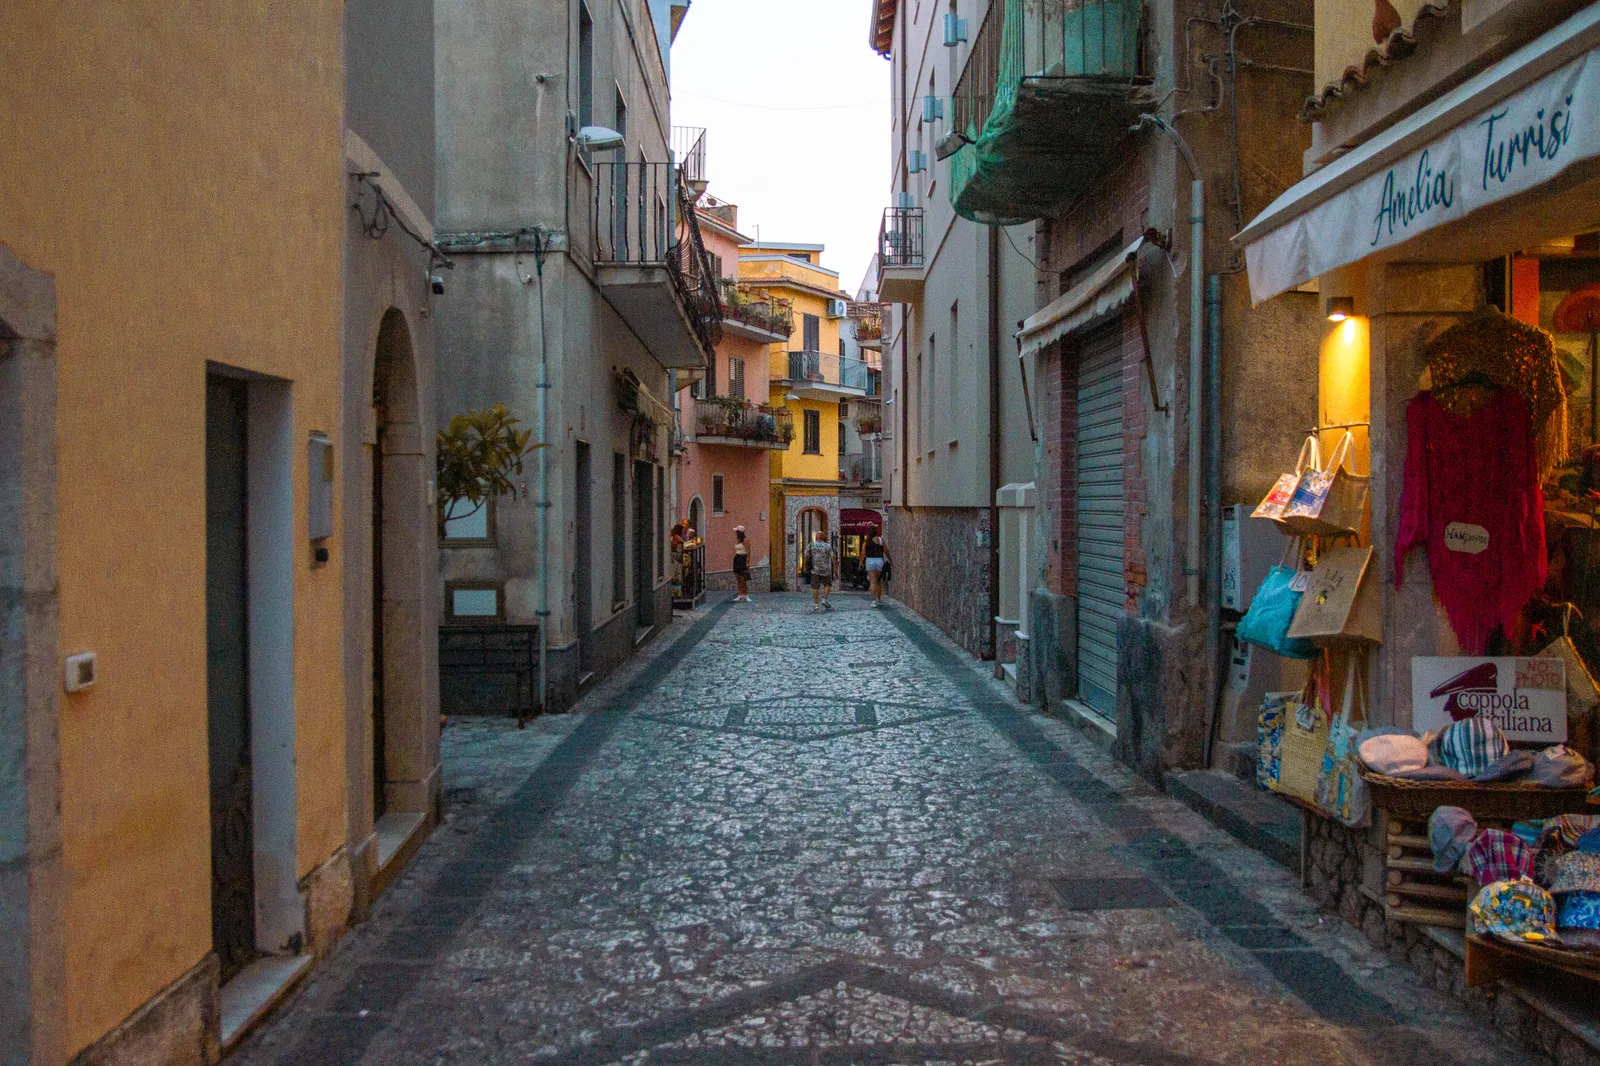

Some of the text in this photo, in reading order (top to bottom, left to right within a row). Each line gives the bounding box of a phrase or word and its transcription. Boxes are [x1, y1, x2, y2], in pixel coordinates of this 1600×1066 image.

[1370, 94, 1574, 246] Amelia Turrisi
[1526, 661, 1549, 673] NO
[1515, 672, 1560, 688] PHOTO
[1457, 687, 1530, 716] coppola
[1475, 709, 1553, 733] ciliana
